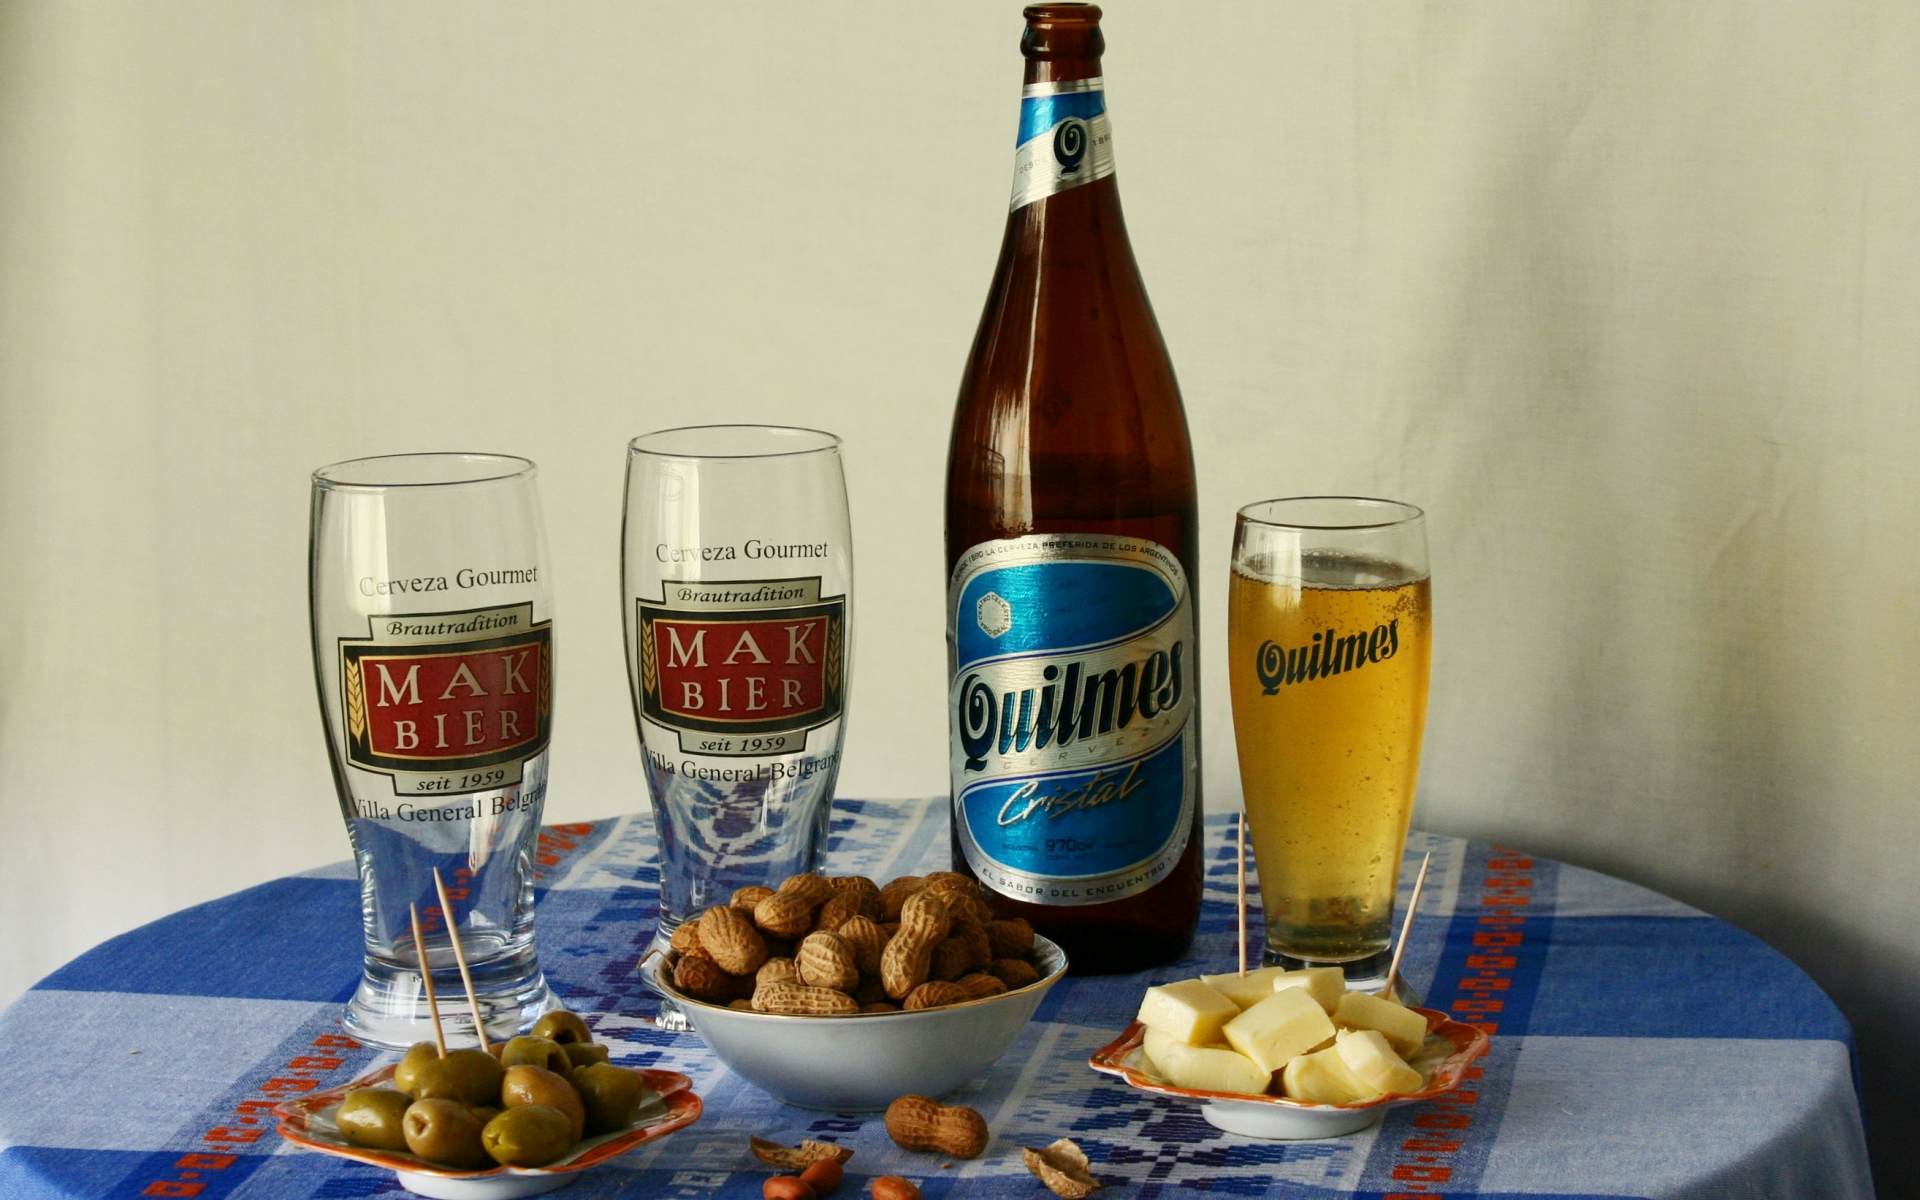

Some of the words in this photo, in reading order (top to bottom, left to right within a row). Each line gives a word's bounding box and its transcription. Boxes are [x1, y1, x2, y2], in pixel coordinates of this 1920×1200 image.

[656, 543, 736, 563] Cerveza
[744, 540, 828, 560] Gourmet
[985, 548, 995, 556] LA
[997, 543, 1039, 553] CERVEZA
[1042, 541, 1099, 549] PREFERIDA
[1119, 544, 1137, 552] LOS
[1140, 546, 1178, 576] ARGENTINOS
[359, 574, 449, 597] Cerveza
[456, 566, 538, 589] Gourmet
[677, 585, 804, 603] Brautradition
[386, 614, 519, 635] Brautradition
[666, 622, 817, 668] MAK
[1256, 618, 1399, 696] Quilmes
[375, 650, 531, 707] MAK
[681, 677, 805, 711] BIER
[959, 641, 1183, 772] Quilmes
[393, 710, 521, 750] BIER
[699, 738, 732, 752] seit
[739, 737, 786, 752] 1959
[1003, 713, 1170, 770] CERVEZA
[416, 774, 451, 791] seit
[458, 769, 505, 788] 1959
[644, 746, 676, 775] Villa
[681, 760, 762, 782] General
[351, 797, 391, 820] Villa
[396, 800, 483, 822] General
[996, 760, 1145, 826] Cristal
[982, 868, 994, 880] EL
[999, 878, 1044, 896] SABOR
[1051, 889, 1079, 897] DEL
[1086, 863, 1165, 896] ENCUENTRO
